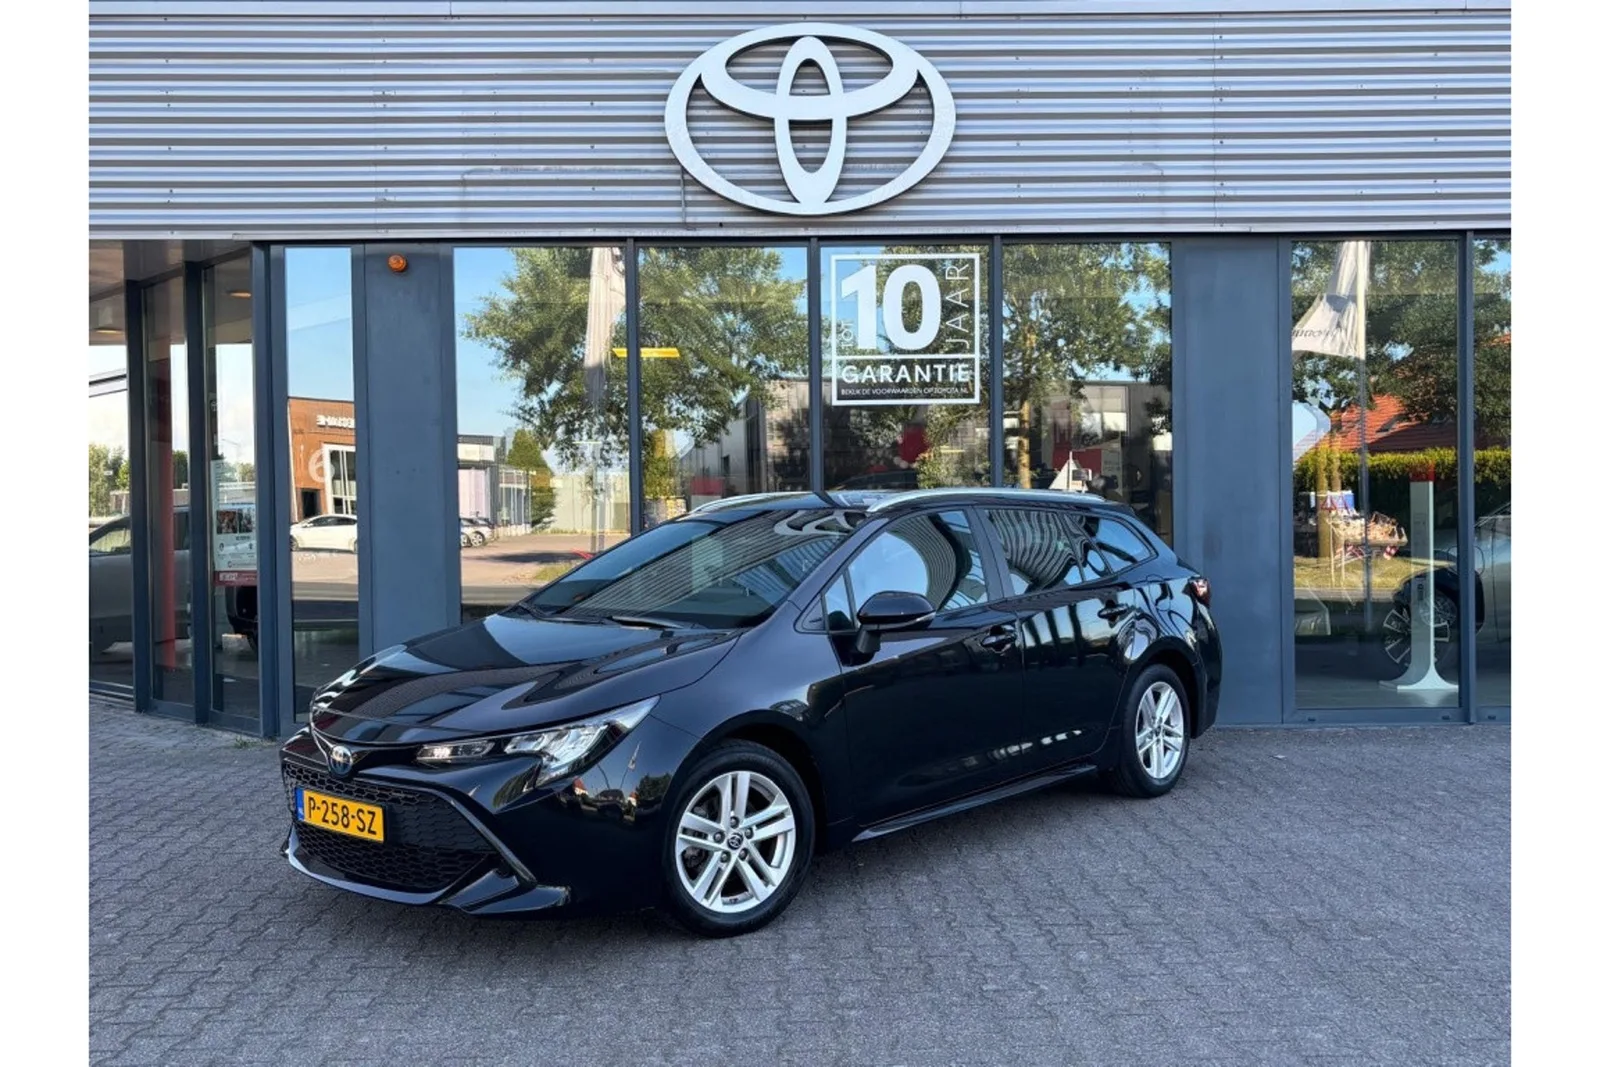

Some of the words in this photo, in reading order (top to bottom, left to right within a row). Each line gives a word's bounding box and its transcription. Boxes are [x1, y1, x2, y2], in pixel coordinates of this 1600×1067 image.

[841, 263, 941, 351] 10
[945, 263, 970, 349] JAAR
[841, 363, 970, 384] GARANTIE
[308, 796, 377, 836] P-258-SZ
